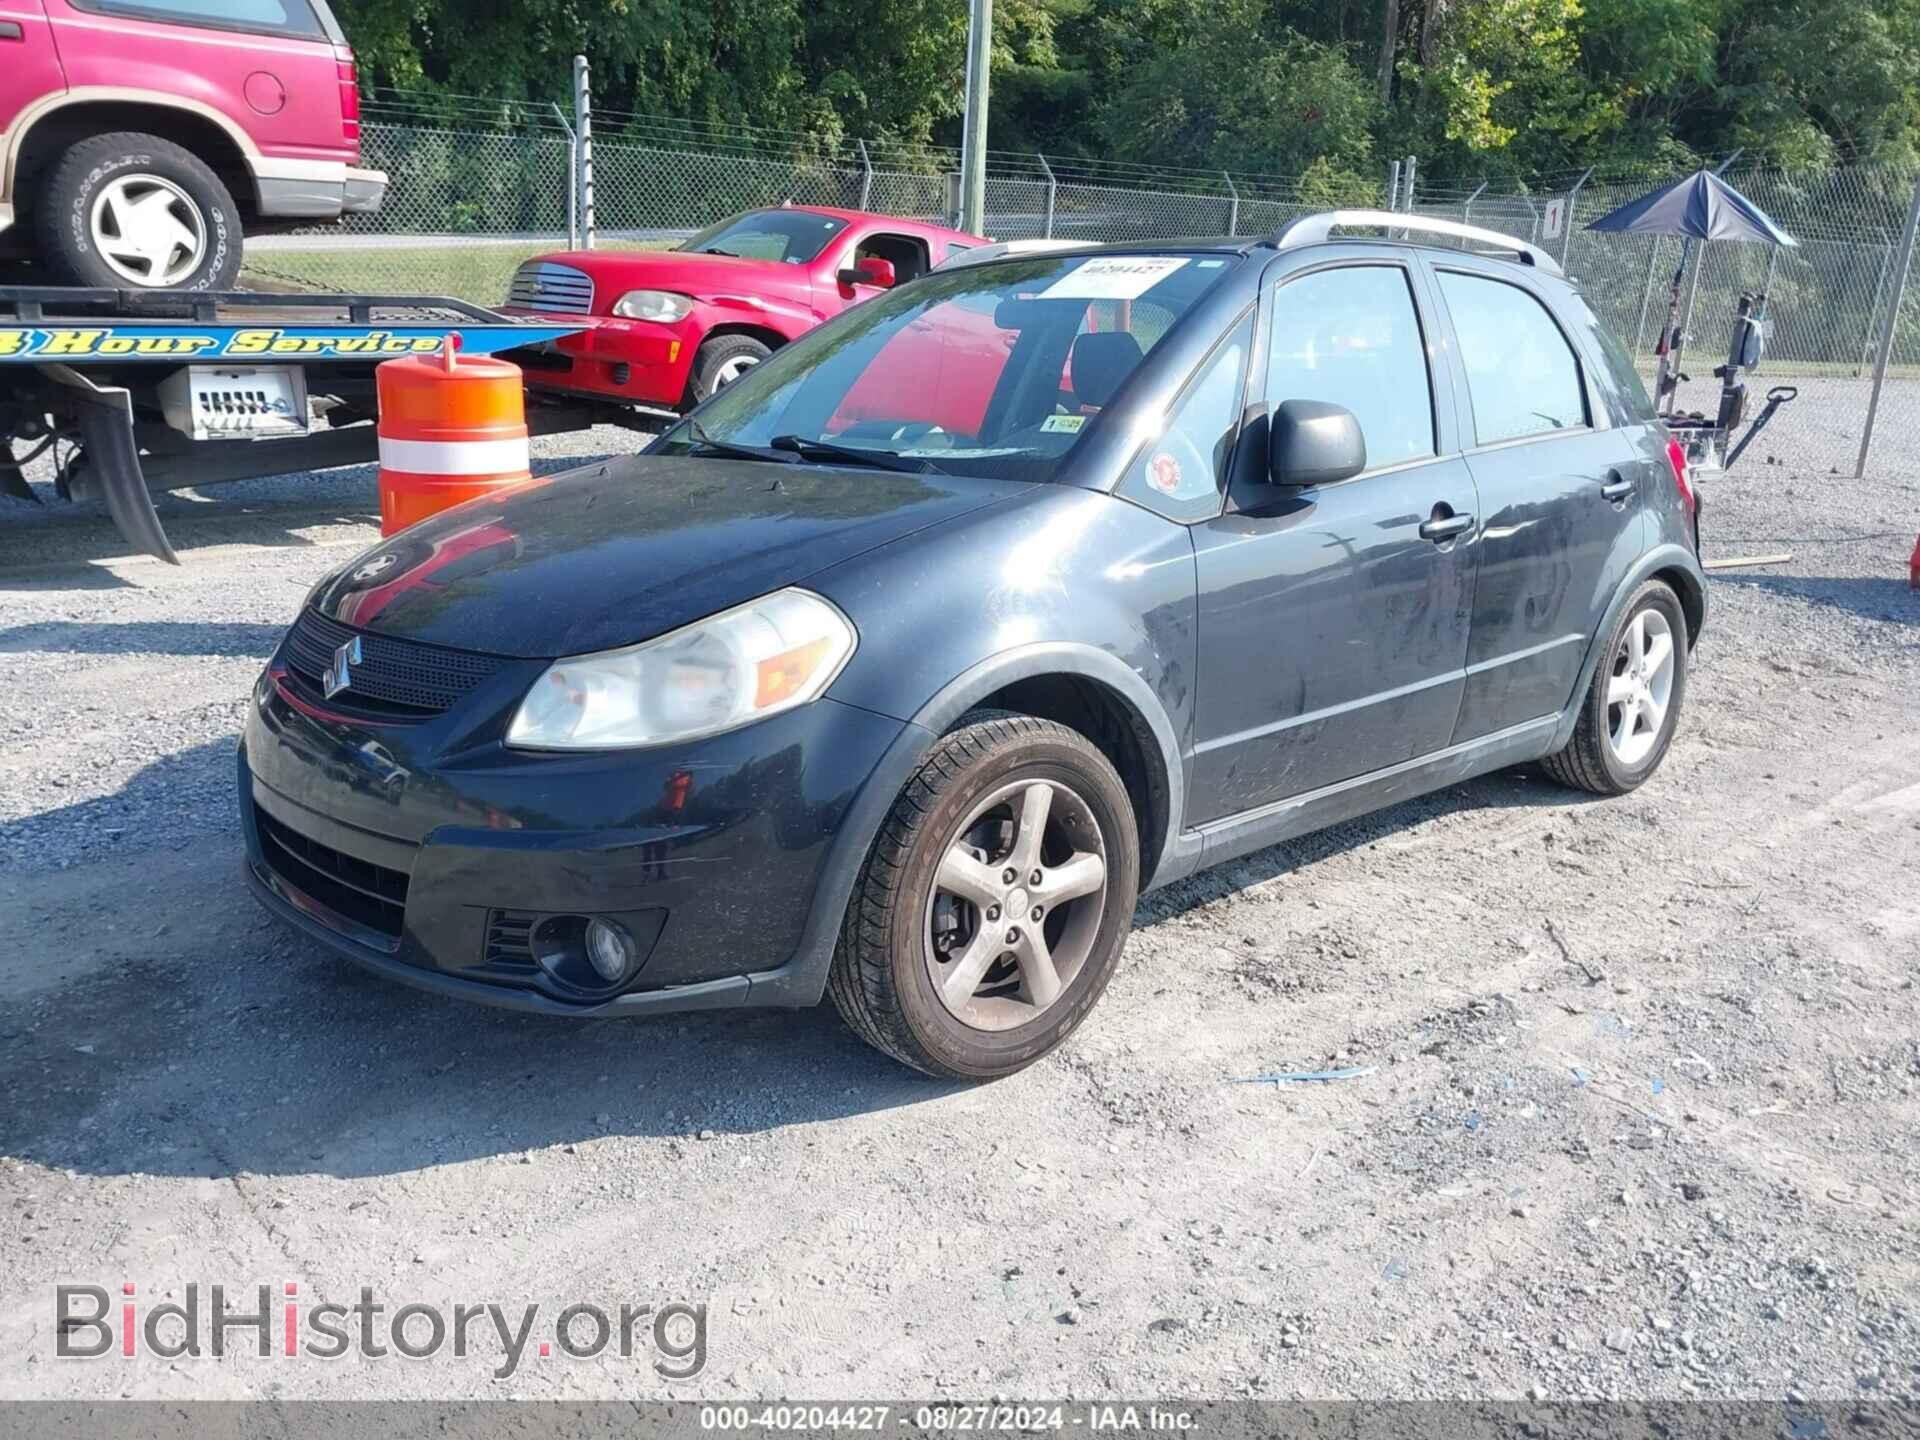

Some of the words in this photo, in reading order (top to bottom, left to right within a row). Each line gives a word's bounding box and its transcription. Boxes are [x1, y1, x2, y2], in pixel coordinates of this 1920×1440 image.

[1551, 208, 1557, 230] 1
[39, 331, 215, 353] Hour
[228, 332, 440, 352] Service
